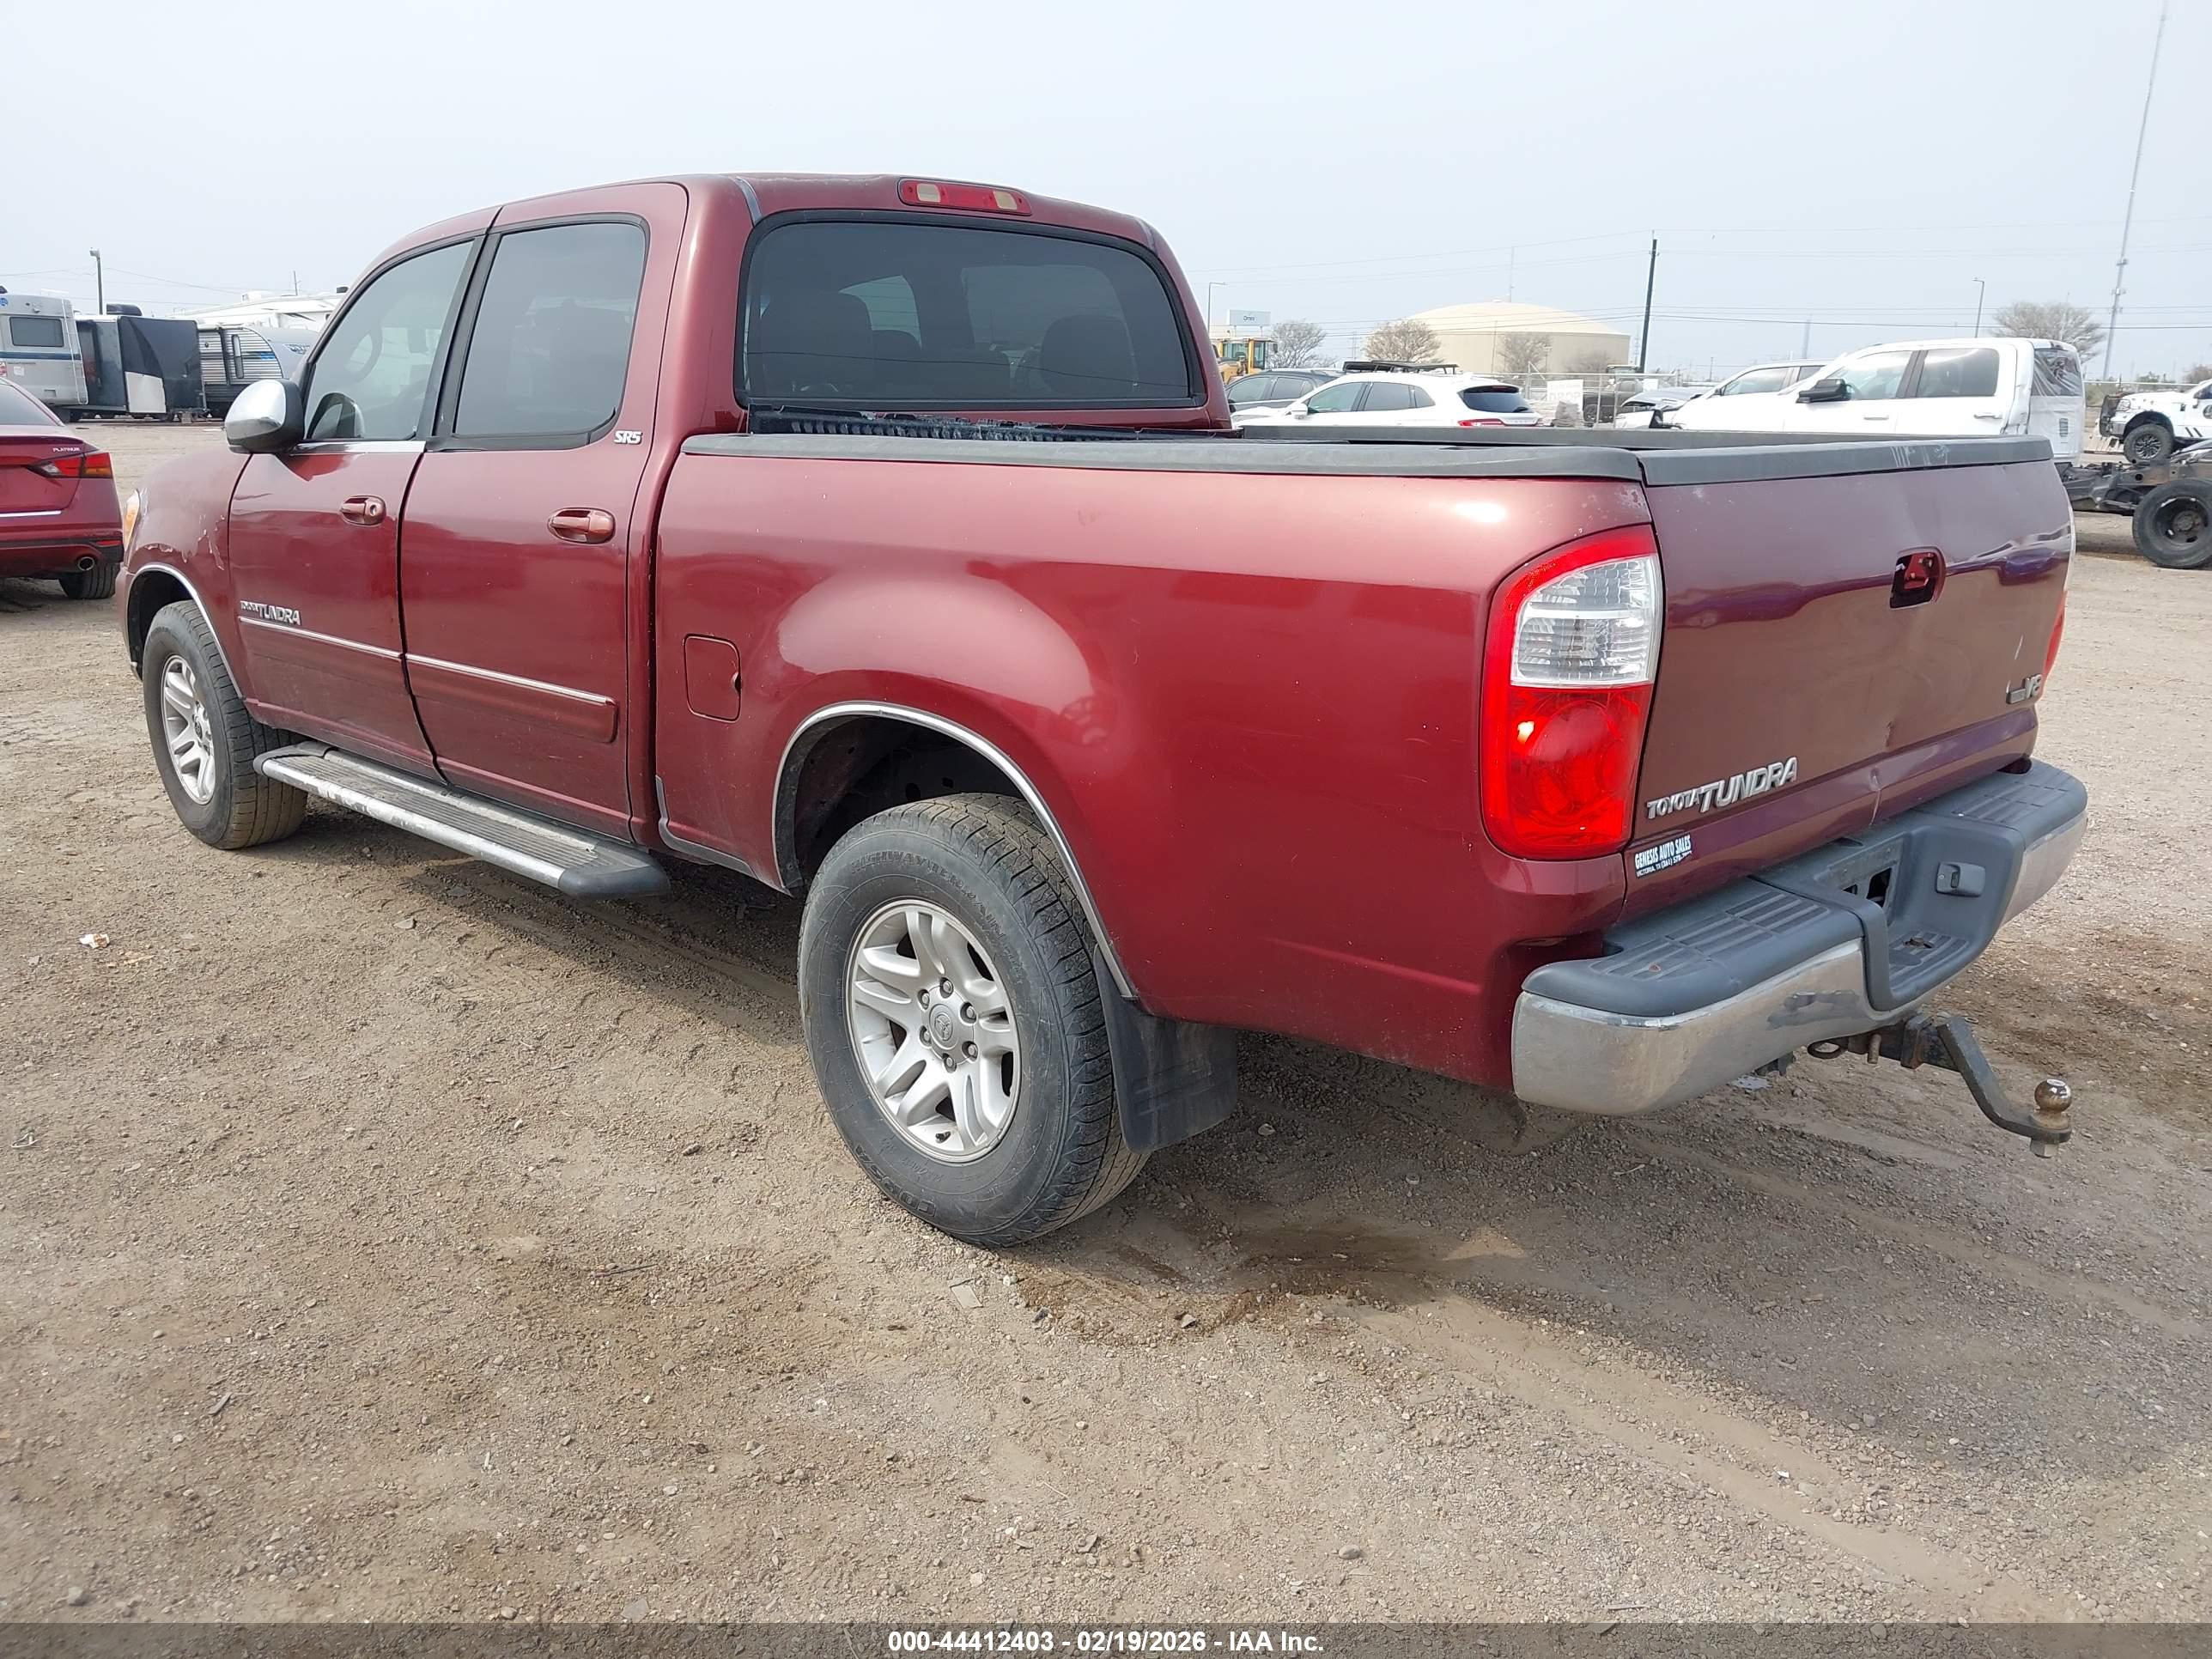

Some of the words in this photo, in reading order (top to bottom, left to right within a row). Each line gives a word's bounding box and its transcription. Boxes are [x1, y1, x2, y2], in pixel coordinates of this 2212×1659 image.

[614, 430, 642, 444] SR5
[258, 604, 301, 626] TUNDRA
[1646, 787, 1700, 819] TOYOTA
[1698, 757, 1798, 813] TUNDRA
[1634, 846, 1659, 870] GENESIS
[1659, 841, 1674, 861] AUTO
[1674, 834, 1692, 854] SALES
